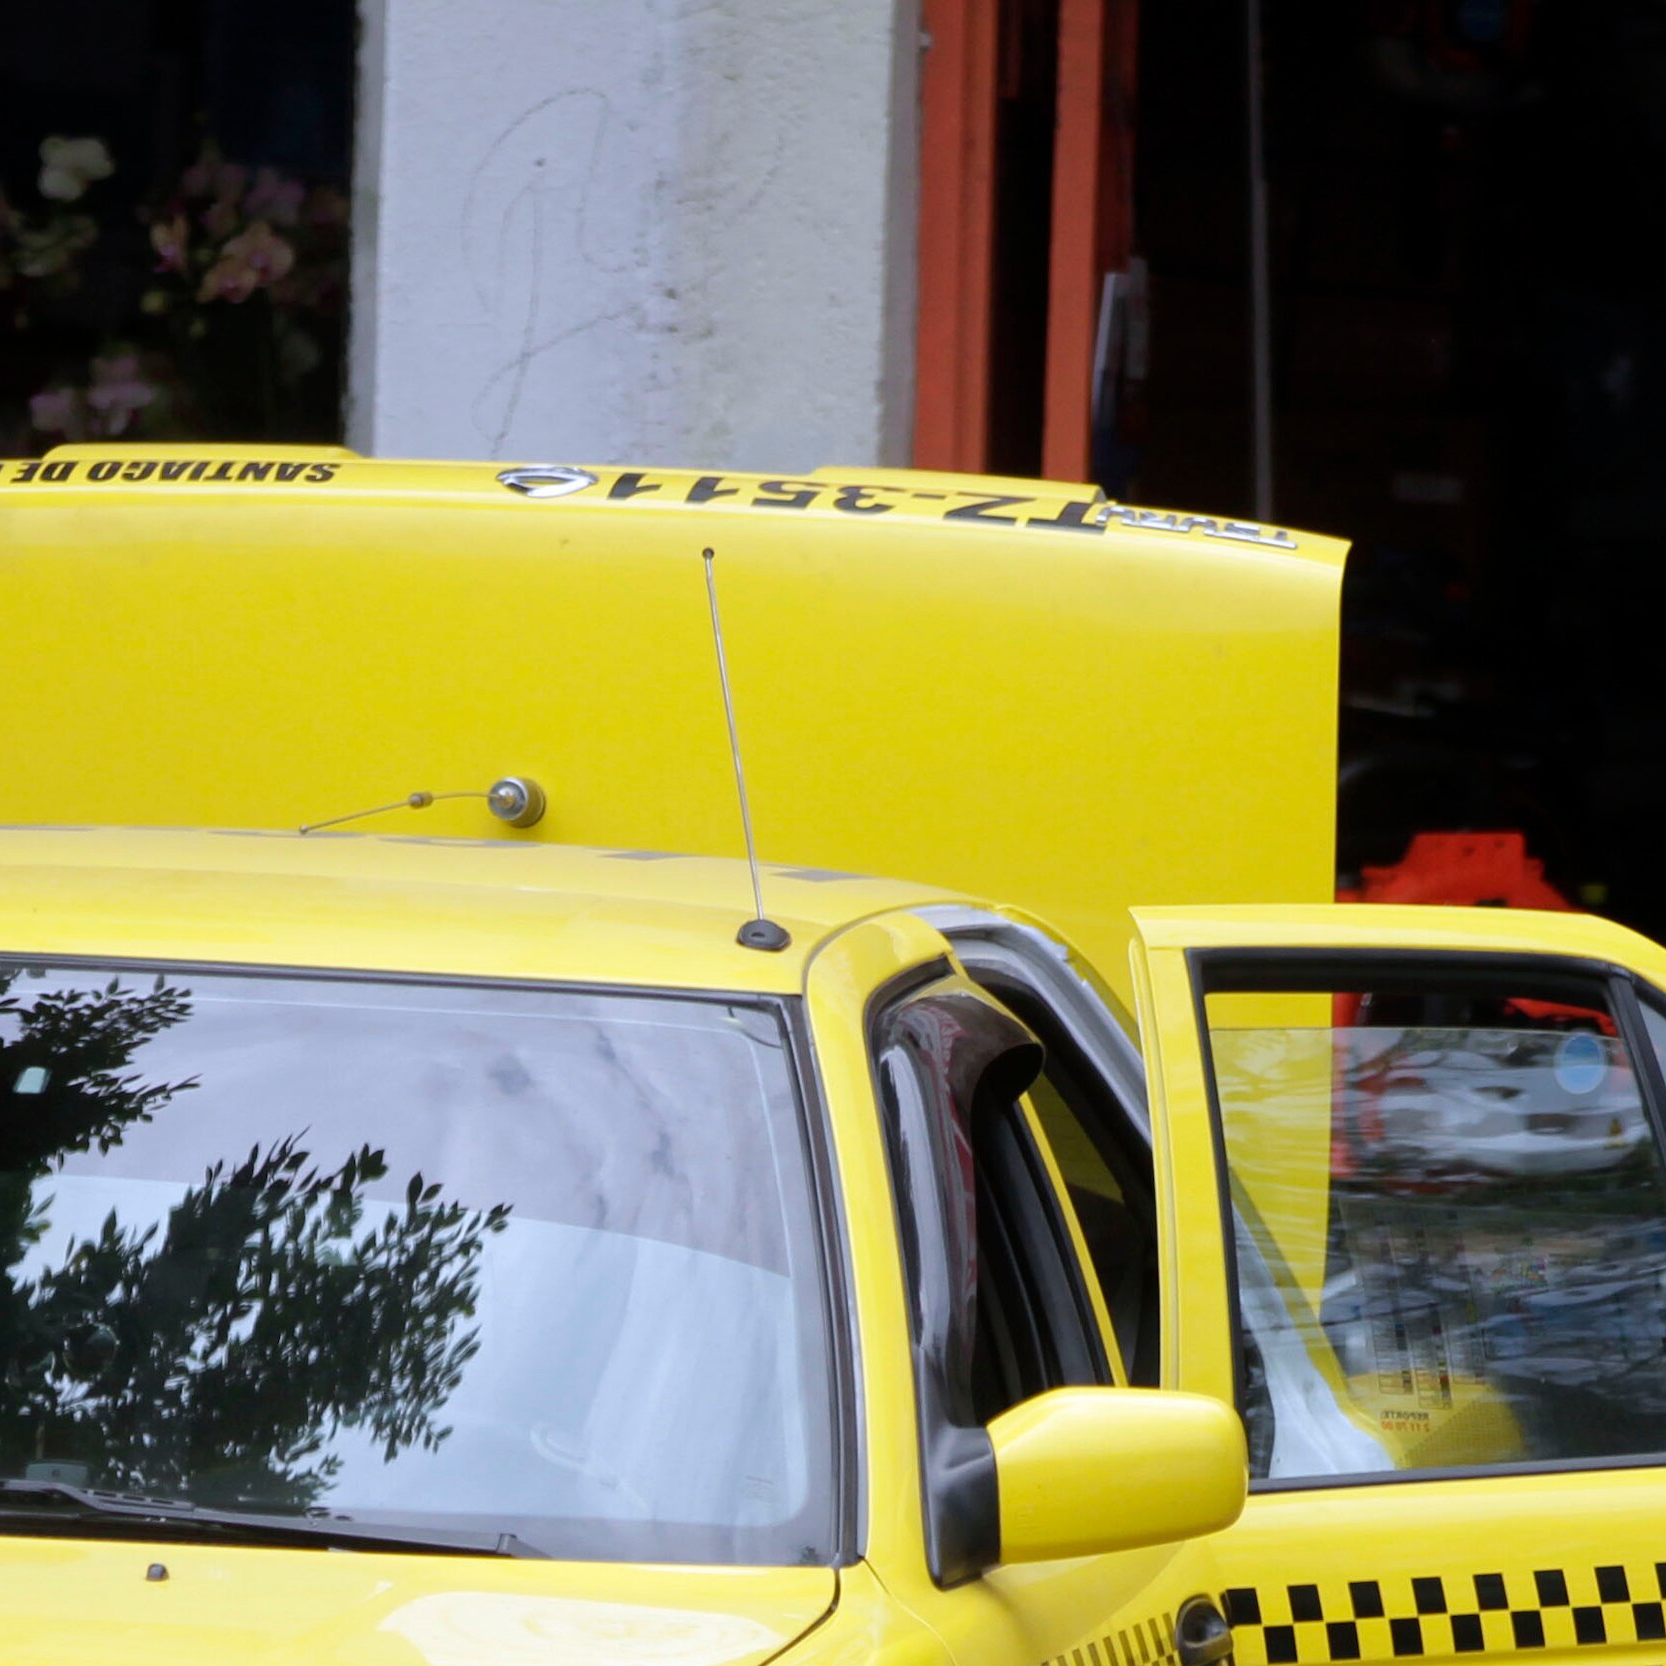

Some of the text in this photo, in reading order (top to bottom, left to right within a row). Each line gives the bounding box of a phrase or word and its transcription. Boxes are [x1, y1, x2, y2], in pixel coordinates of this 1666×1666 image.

[10, 461, 80, 484] DE
[85, 461, 341, 483] SANTIAGO
[606, 472, 1107, 535] TZ-3511
